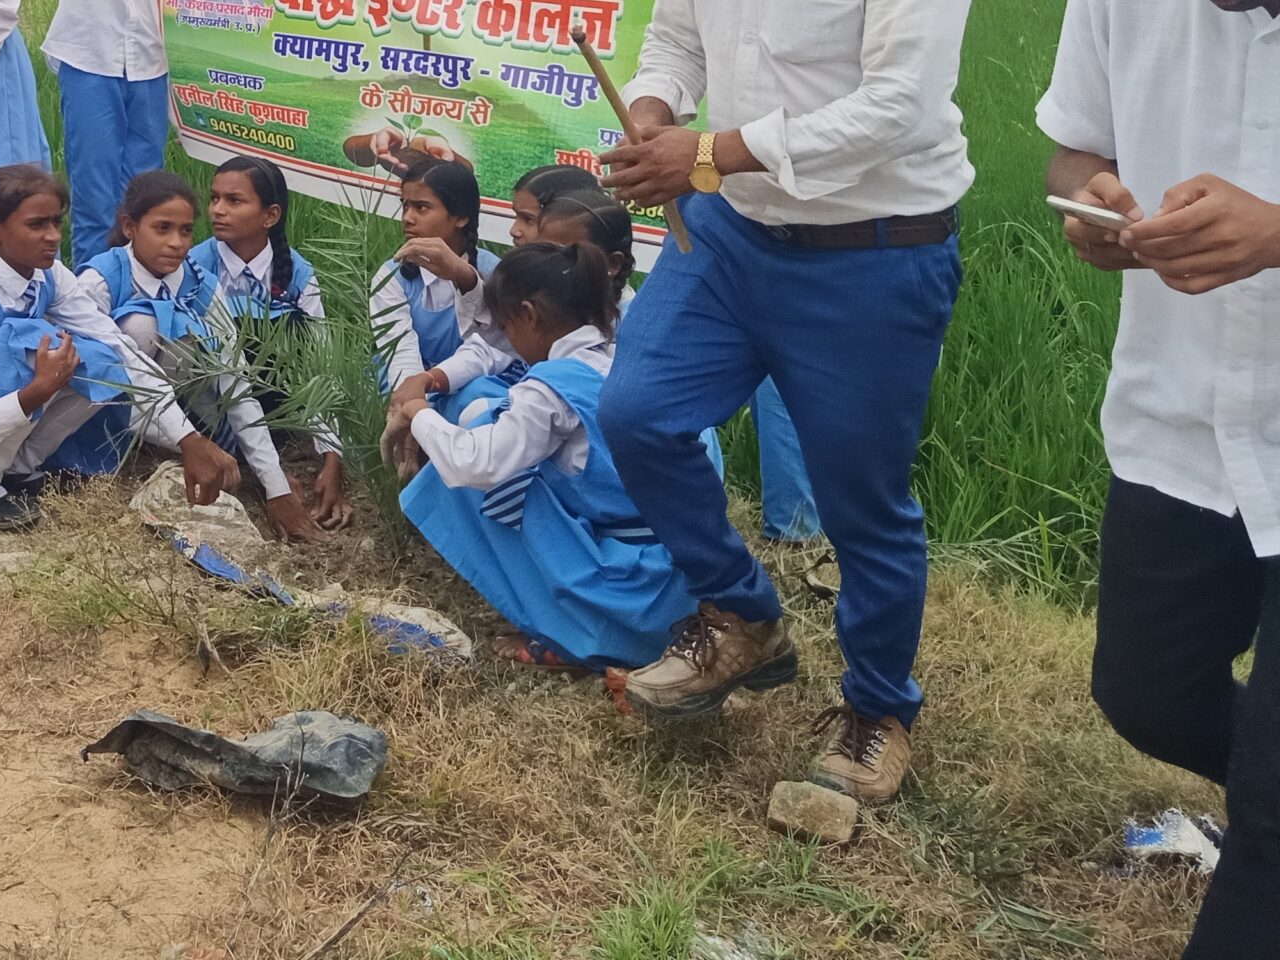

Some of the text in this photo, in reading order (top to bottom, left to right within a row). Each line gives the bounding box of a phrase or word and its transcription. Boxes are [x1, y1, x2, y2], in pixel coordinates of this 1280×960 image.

[361, 83, 491, 125] के सौजन्य से
[500, 64, 599, 107] गाजीपुर
[247, 100, 309, 128] कुशवाहा
[210, 118, 295, 151] 9415240400
